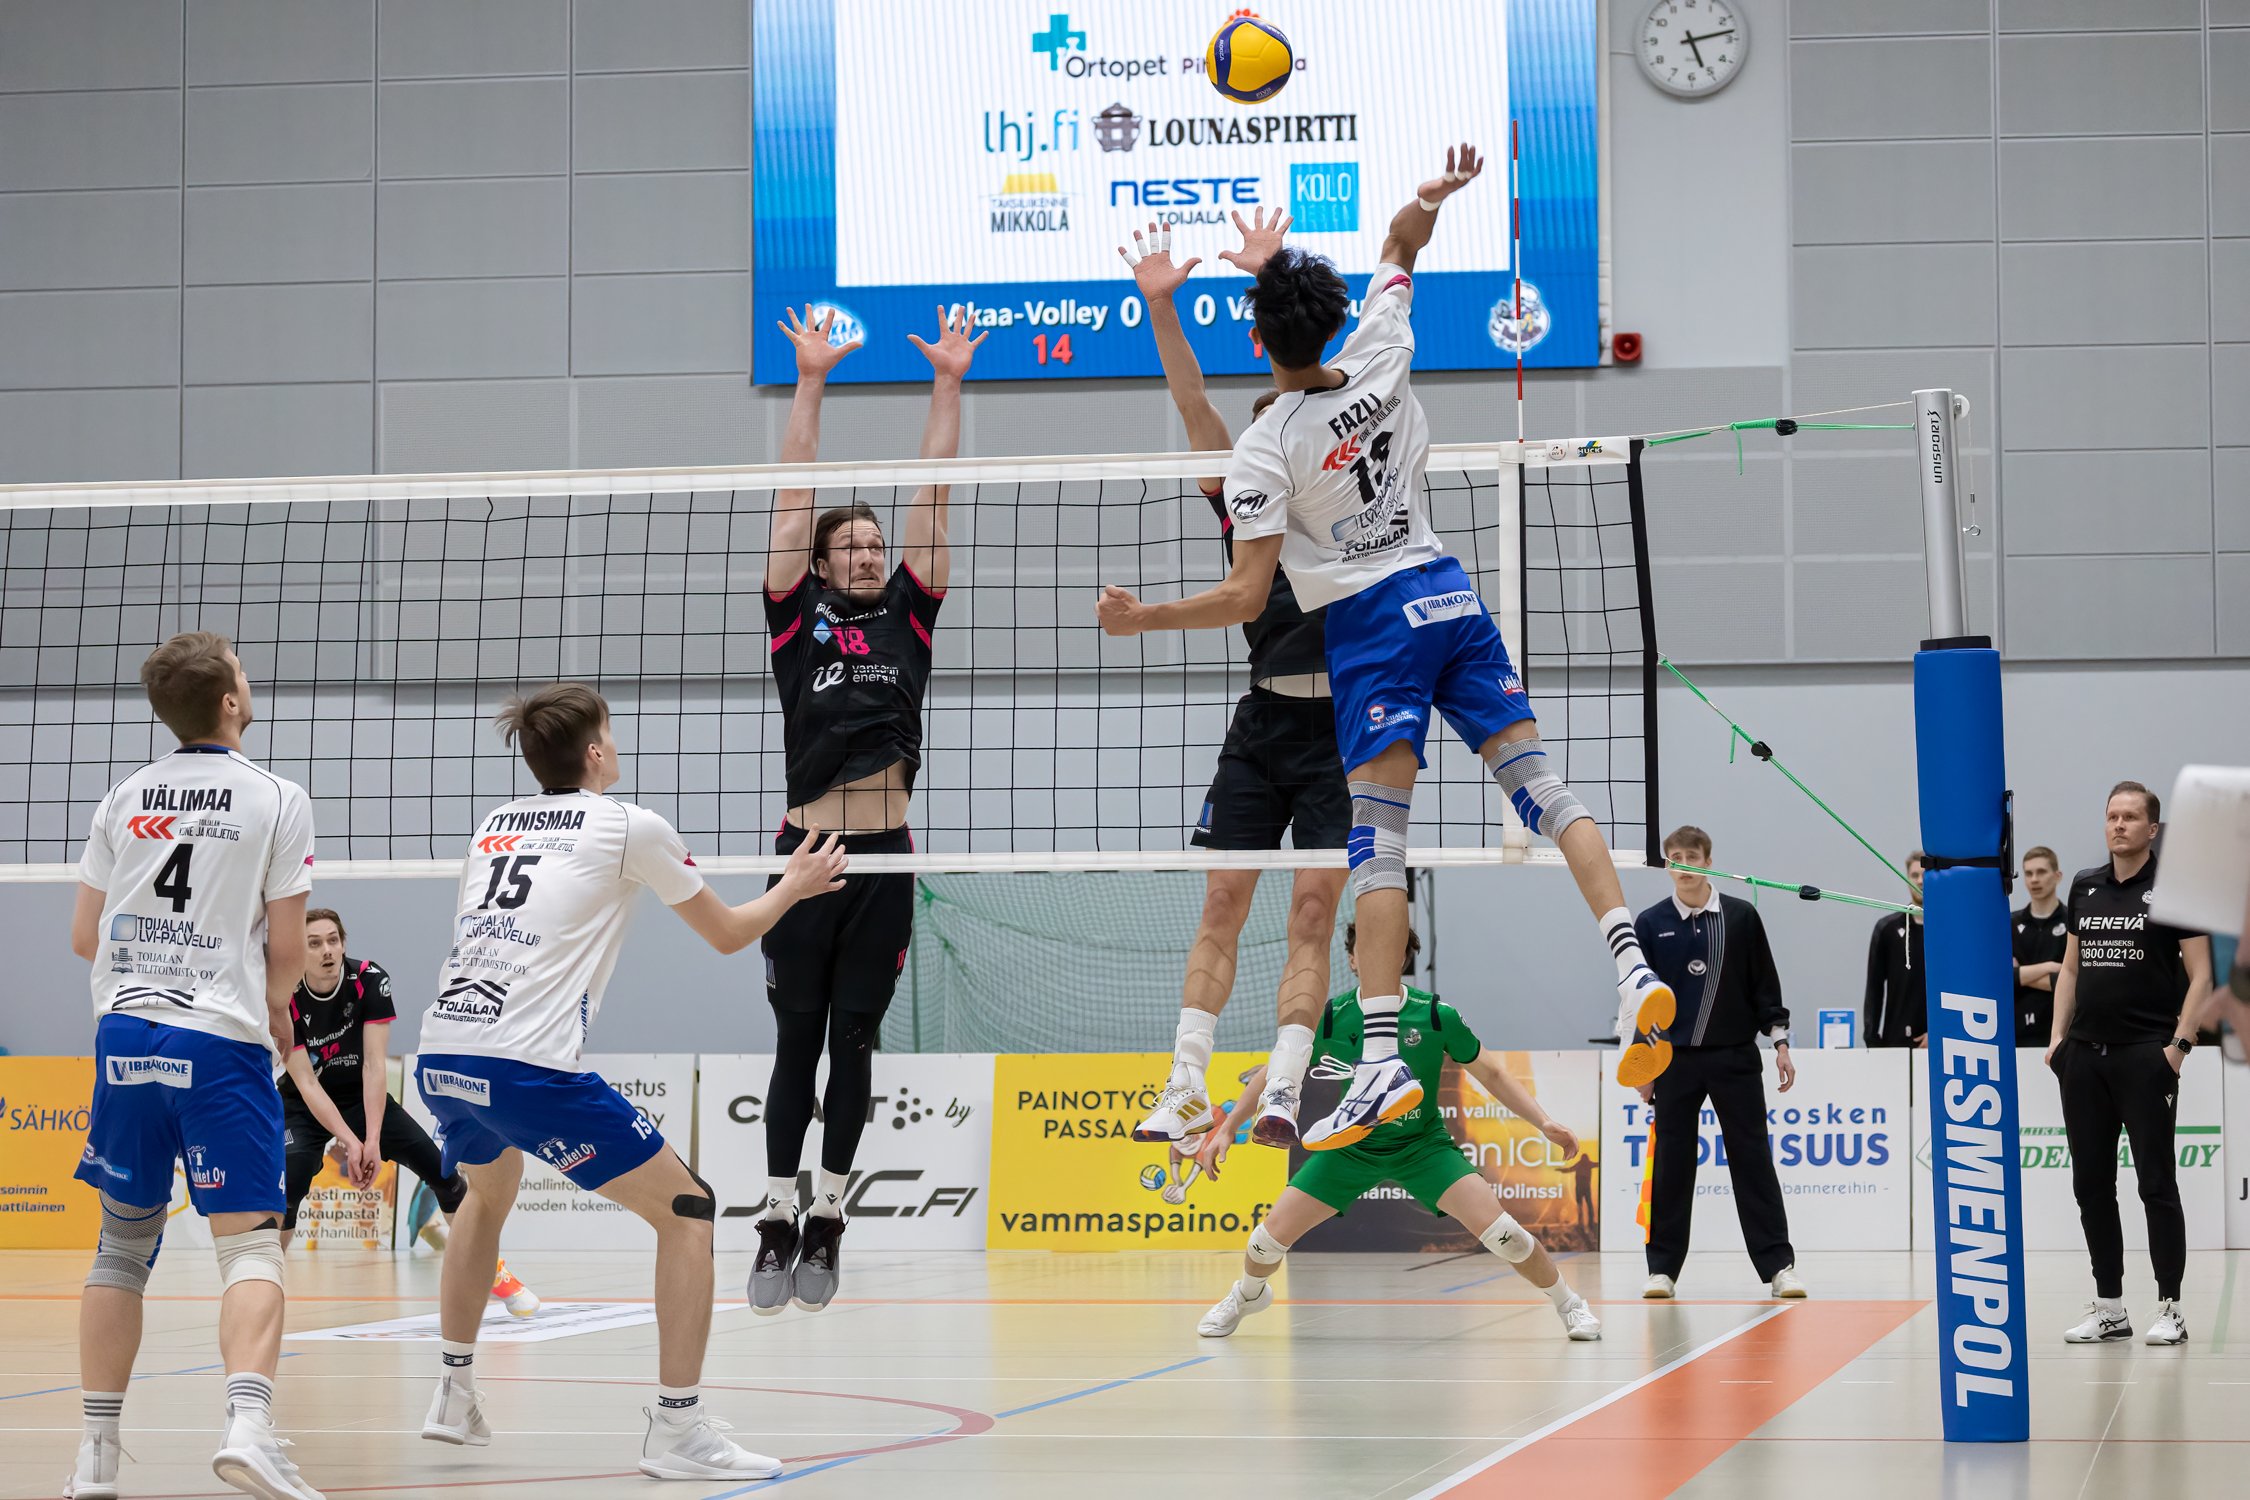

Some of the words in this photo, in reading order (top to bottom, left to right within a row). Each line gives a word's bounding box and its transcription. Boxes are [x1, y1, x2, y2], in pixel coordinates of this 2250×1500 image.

[1065, 56, 1167, 81] Ortopet
[984, 110, 1080, 161] lhj.fi
[1149, 115, 1358, 146] LOUNASPIRTTI
[1111, 177, 1260, 207] NESTE
[1296, 172, 1352, 202] KOLO
[991, 210, 1069, 233] MIKKOLA
[1156, 211, 1226, 226] TOIJALA
[947, 299, 1109, 331] Akaa-Volley
[1120, 296, 1142, 327] 0
[1194, 294, 1216, 325] 0
[1033, 334, 1073, 364] 14
[1328, 393, 1382, 440] FAZLI
[1930, 418, 1943, 484] UNISPORT
[830, 626, 871, 656] 18
[142, 784, 232, 812] VÄLIMAA
[485, 810, 586, 832] TYYNISMAA
[205, 827, 240, 841] KULJETUS
[153, 843, 194, 913] 4
[477, 855, 542, 910] 15
[138, 917, 194, 933] TOIJALAN
[2079, 913, 2148, 930] MENEVÄ
[140, 930, 216, 949] LVI-PALVELU
[137, 952, 184, 964] TOIJALAN
[2081, 948, 2104, 959] 0800
[2107, 948, 2144, 960] 02120
[136, 964, 197, 977] TILITOIMISTO
[200, 970, 216, 980] OY
[514, 964, 529, 975] OY
[437, 999, 502, 1017] TOIJALAN
[111, 1059, 188, 1081] VIBRAKONE
[326, 1059, 358, 1067] nergia
[427, 1072, 486, 1094] VIBRAKONE
[1018, 1084, 1162, 1110] PAINOTYÖ
[10, 1104, 91, 1131] SÄHKÖ
[728, 1095, 888, 1124] CAT
[944, 1097, 975, 1128] by
[1623, 1103, 1886, 1125] Tamkosken
[631, 1115, 653, 1141] 15
[1509, 1137, 1565, 1167] ICL
[2178, 1145, 2221, 1168] OY
[213, 1167, 226, 1185] Oy
[342, 1188, 381, 1204] myös
[1783, 1182, 1876, 1195] bannereihin
[1941, 991, 2013, 1407] PESMENPOL
[516, 1199, 566, 1211] vuoden
[1000, 1204, 1273, 1238] vammaspaino.fi
